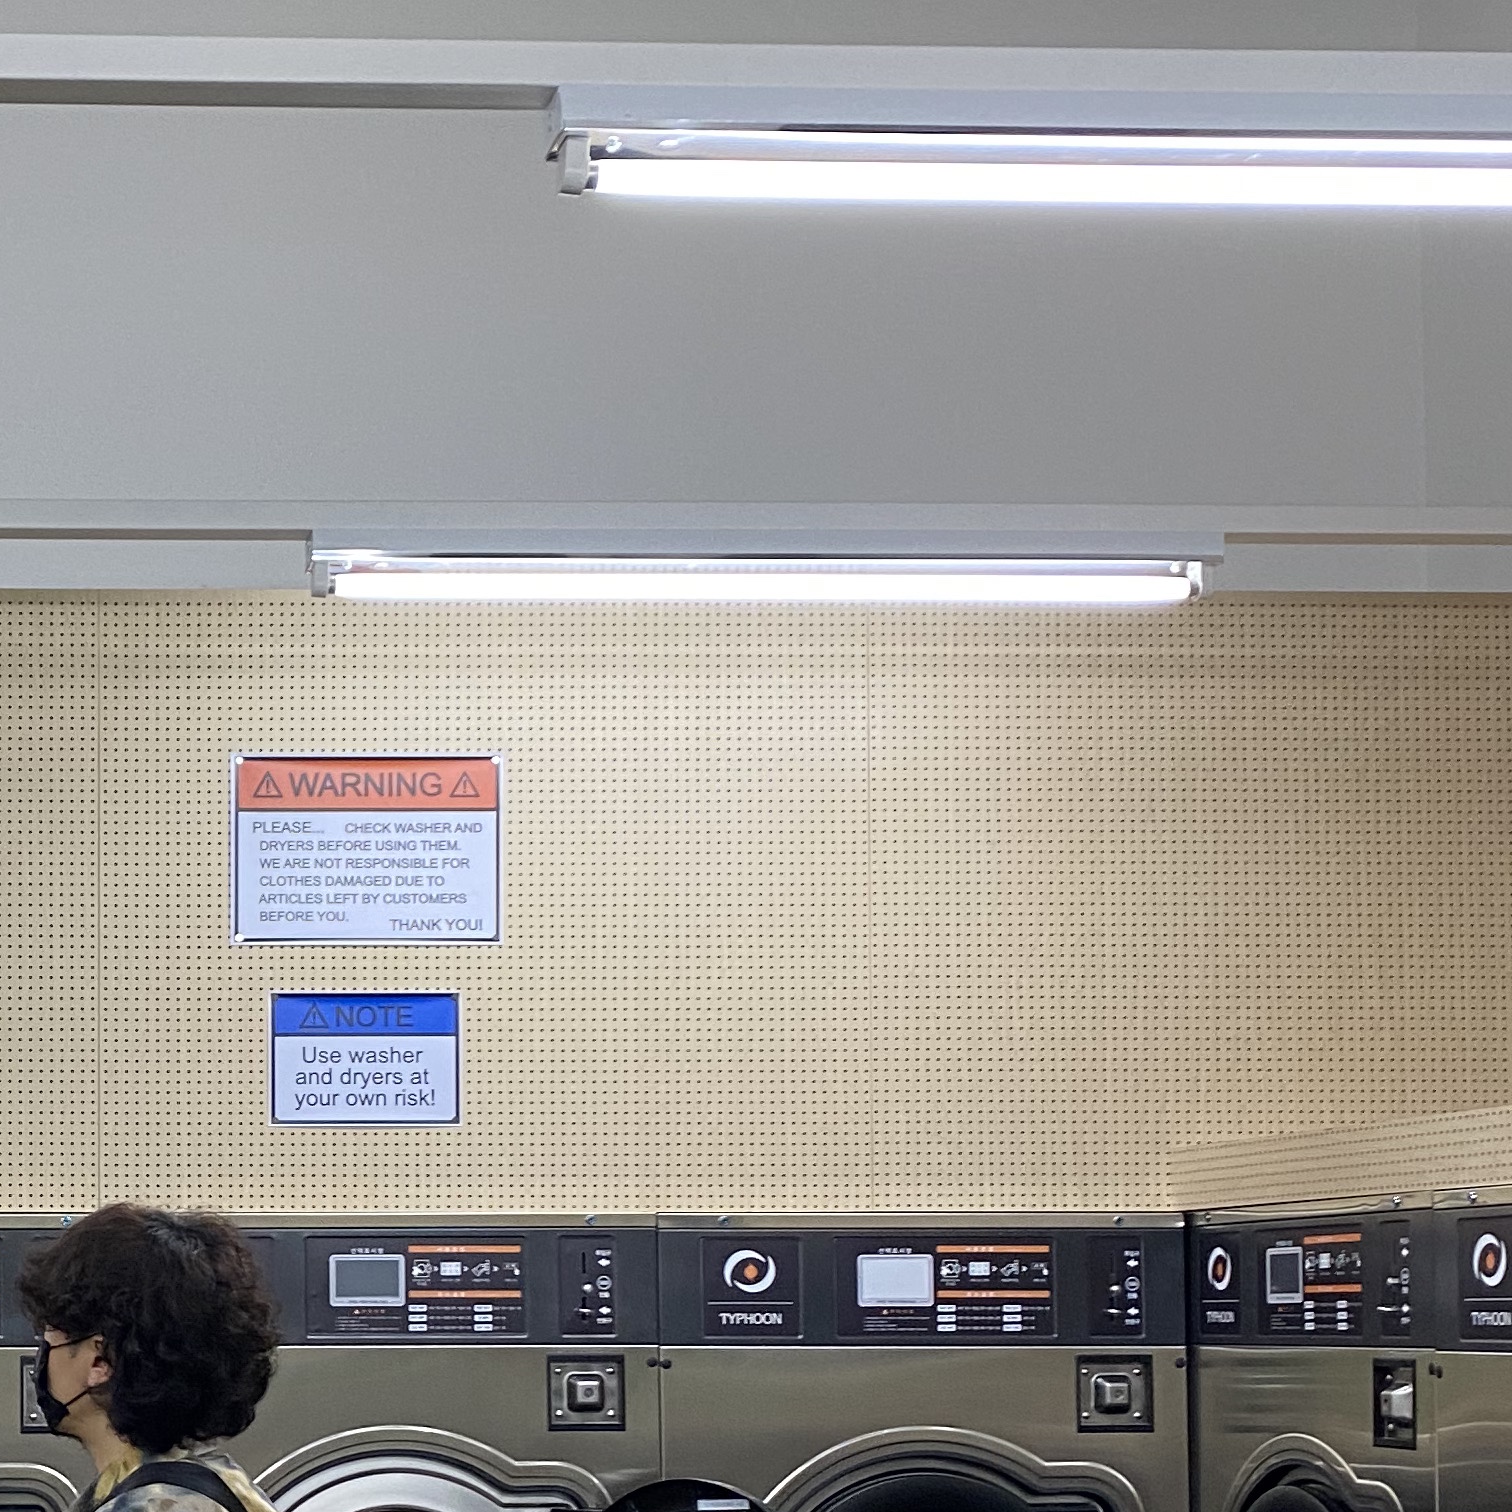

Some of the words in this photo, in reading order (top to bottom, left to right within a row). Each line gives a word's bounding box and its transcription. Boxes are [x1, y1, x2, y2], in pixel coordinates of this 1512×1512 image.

[288, 771, 442, 797] WARNING
[345, 822, 390, 834] CHECK
[394, 823, 452, 834] WASHER
[454, 823, 483, 834] AND
[259, 840, 314, 851] DRYERS
[318, 840, 371, 851] BEFORE
[375, 840, 417, 851] USING
[420, 840, 461, 851] THEM.
[259, 858, 281, 869] WE
[283, 858, 310, 869] ARE
[314, 858, 342, 869] NOT
[345, 858, 438, 869] RESPONSIBLE
[441, 858, 470, 869] FOR
[259, 875, 321, 887] CLOTHES
[325, 875, 392, 887] DAMAGED
[395, 875, 423, 887] DUE
[426, 875, 445, 887] TO
[258, 893, 323, 905] ARTICLES
[326, 893, 358, 905] LEFT
[362, 893, 380, 905] BY
[383, 893, 467, 905] CUSTOMERS
[259, 911, 314, 922] BEFORE
[316, 911, 349, 922] YOU.
[389, 919, 441, 931] THANK
[444, 919, 483, 931] YOU!
[335, 1006, 414, 1028] NOTE
[302, 1046, 342, 1063] Use
[348, 1046, 423, 1063] washer
[295, 1068, 332, 1085] and
[340, 1068, 403, 1089] dryers
[409, 1068, 429, 1085] at
[294, 1092, 339, 1110] your
[346, 1092, 387, 1106] own
[394, 1089, 436, 1106] risk!
[718, 1312, 783, 1325] TYPHOON
